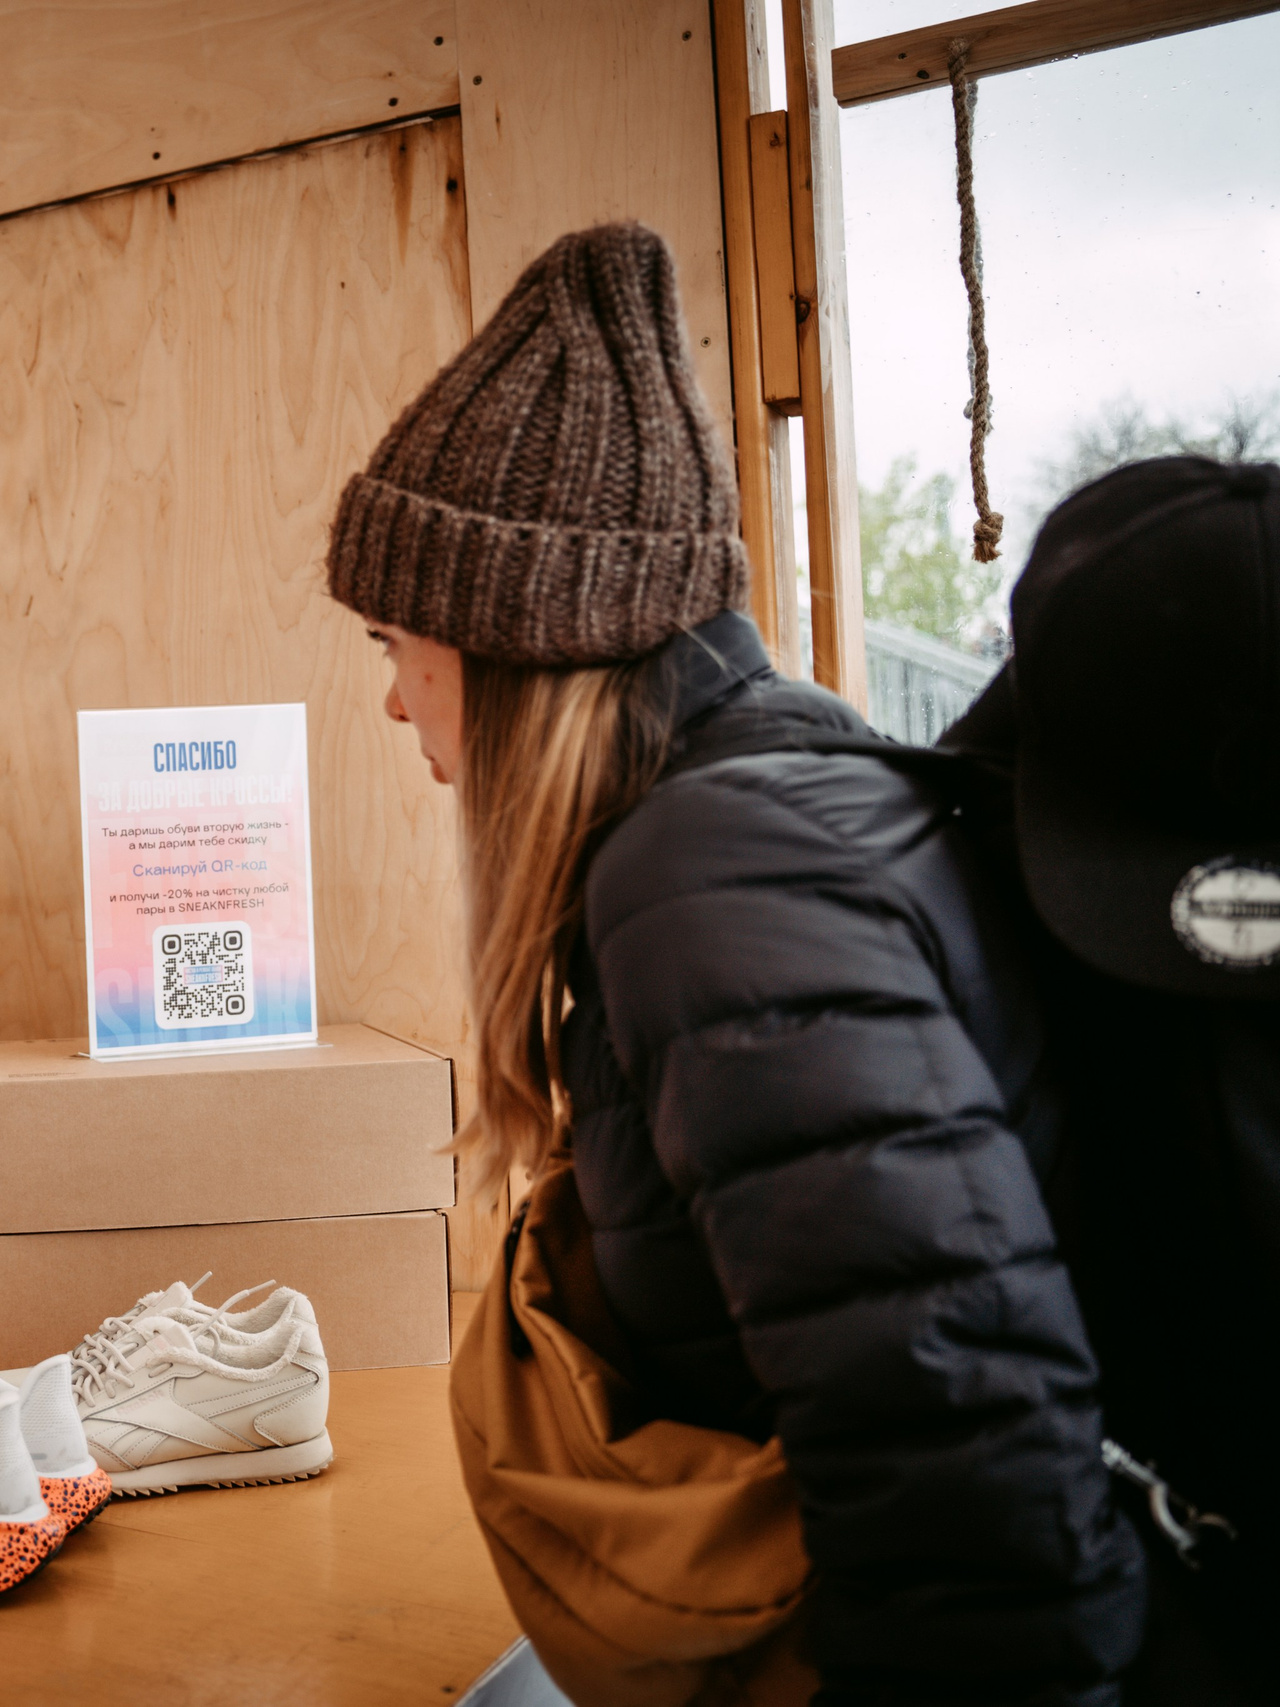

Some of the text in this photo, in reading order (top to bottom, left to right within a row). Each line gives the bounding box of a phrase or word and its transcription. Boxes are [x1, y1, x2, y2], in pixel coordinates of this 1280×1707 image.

[153, 740, 237, 773] СПАСИБО
[98, 773, 293, 813] ЗА ДОБРЫЕ КРОССЫ!
[102, 827, 117, 837] Ты
[120, 825, 164, 838] даришь
[167, 823, 200, 836] обуви
[203, 822, 244, 834] вторую
[247, 820, 282, 831] жизнь
[128, 835, 268, 851] а мы дарим тебе скидку
[132, 859, 268, 877] Сканируй QR-код
[109, 882, 289, 904] и получи -20% на чистку любой
[136, 898, 265, 916] пары в SNEAKNFRESH
